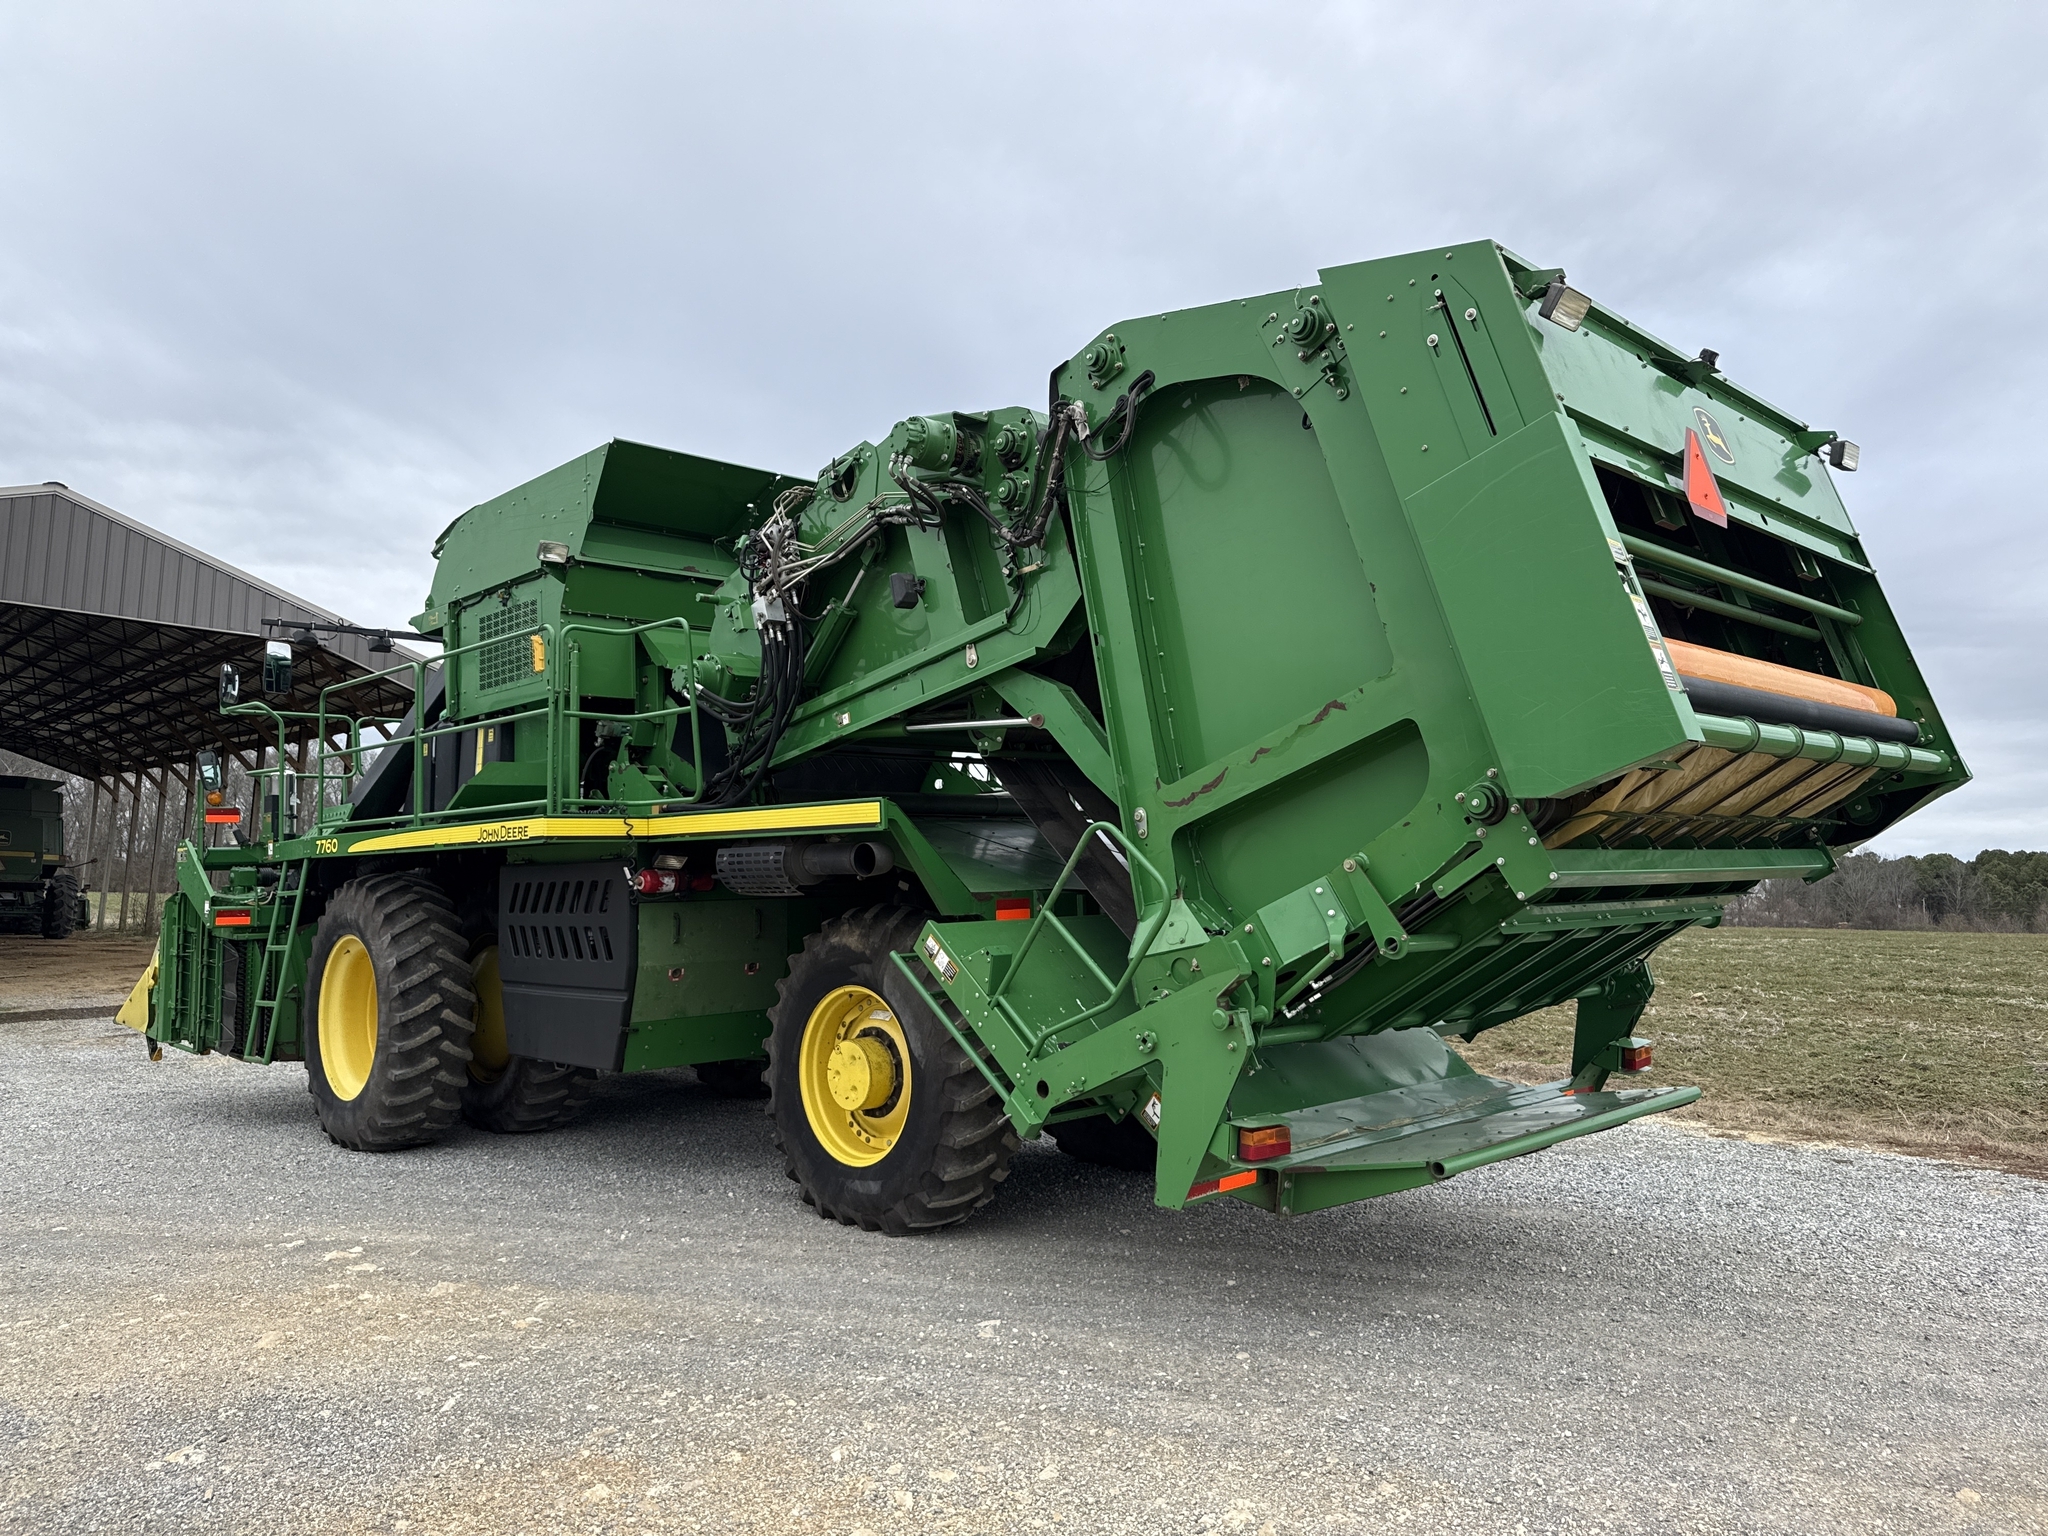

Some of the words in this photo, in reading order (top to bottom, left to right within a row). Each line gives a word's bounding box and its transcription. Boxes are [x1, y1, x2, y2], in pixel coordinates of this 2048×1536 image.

[477, 827, 500, 842] JOHN
[500, 825, 529, 840] DEERE
[315, 838, 339, 855] 7760
